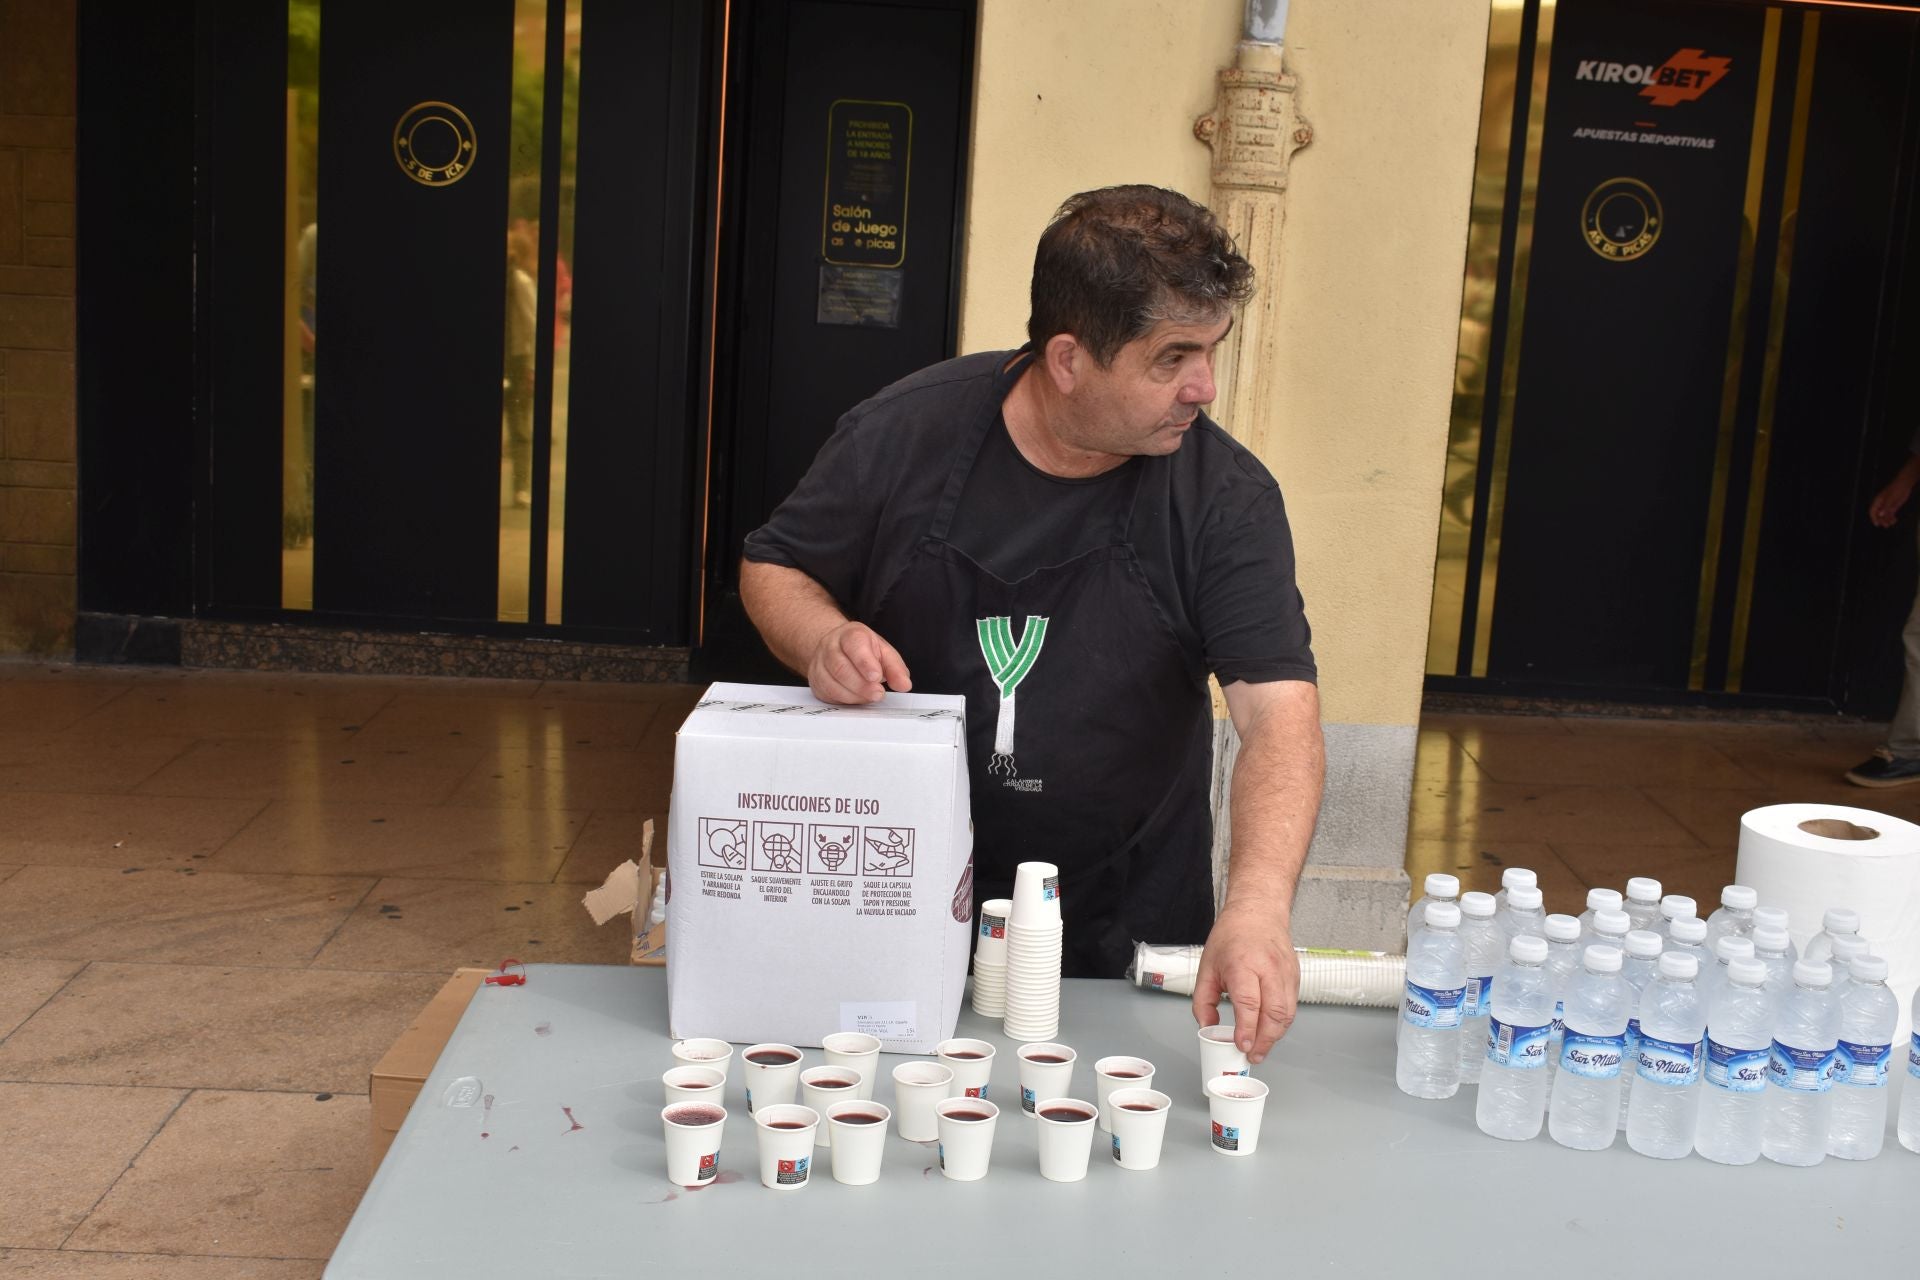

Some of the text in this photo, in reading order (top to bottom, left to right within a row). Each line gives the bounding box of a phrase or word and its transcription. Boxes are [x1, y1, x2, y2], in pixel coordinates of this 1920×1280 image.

[1576, 60, 1711, 89] KIROLBET
[846, 130, 893, 140] LA ENTRADA
[1573, 127, 1716, 149] APUESTAS DEPORTIVAS
[854, 140, 891, 150] MENORES
[847, 150, 857, 158] DE
[417, 169, 433, 181] DE
[832, 204, 871, 219] Salón
[832, 219, 898, 237] de Juego
[866, 238, 896, 250] picas
[1588, 229, 1653, 256] AS DE PICAS
[738, 792, 880, 816] INSTRUCCIONES DE USO
[701, 870, 716, 879] ESTIRE
[724, 873, 743, 882] SOLAPA
[770, 876, 802, 886] SUAVEMENTE
[707, 880, 734, 890] ARRANQUE
[735, 883, 741, 891] LA
[811, 879, 829, 887] AJUSTE
[837, 880, 853, 888] GRIFO
[863, 881, 881, 889] SAQUE
[702, 889, 741, 900] PARTE REDONDA
[766, 886, 782, 894] GRIFO
[813, 889, 849, 897] ENCAJANDOLO
[870, 890, 901, 898] PROTECCION
[764, 895, 788, 903] INTERIOR
[831, 898, 850, 906] SOLAPA
[864, 908, 885, 916] VALVULA
[894, 908, 916, 916] VACIADO
[1521, 1045, 1543, 1057] San
[1567, 1050, 1590, 1064] San
[1639, 1053, 1691, 1074] San Millán
[1733, 1068, 1758, 1081] San
